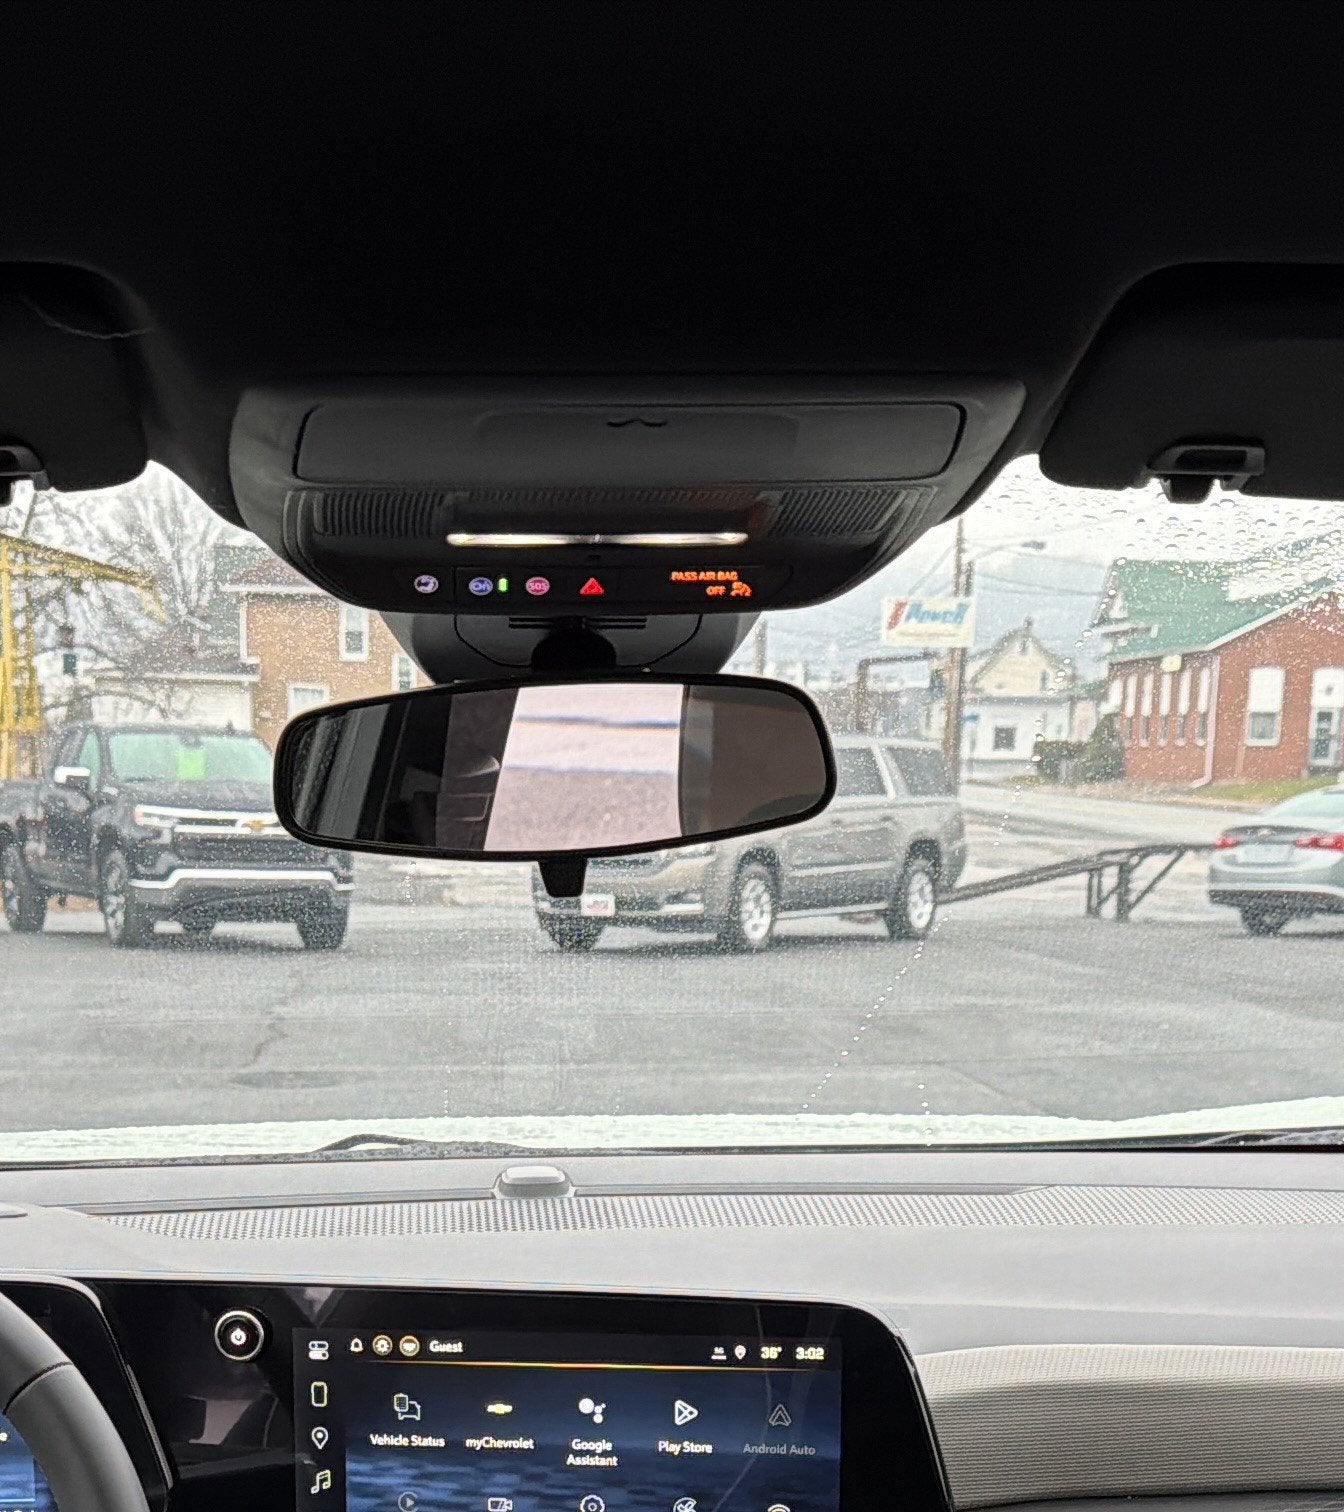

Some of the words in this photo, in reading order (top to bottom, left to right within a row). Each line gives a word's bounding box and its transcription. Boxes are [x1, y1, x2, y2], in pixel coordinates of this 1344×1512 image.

[671, 571, 697, 581] PASS
[698, 571, 716, 581] AIR
[717, 571, 739, 582] BAG
[528, 580, 548, 591] SOS
[706, 586, 726, 596] OFF
[429, 1340, 464, 1353] Guest
[761, 1346, 783, 1359] 36°
[795, 1347, 825, 1360] 3:02
[369, 1433, 409, 1446] Vehicle
[410, 1435, 446, 1448] Status
[465, 1437, 535, 1451] myChevrolet
[571, 1439, 613, 1454] Google
[658, 1440, 682, 1456] Play
[683, 1441, 714, 1454] Store
[743, 1443, 788, 1455] Android
[789, 1444, 817, 1456] Auto
[566, 1454, 619, 1467] Assistant
